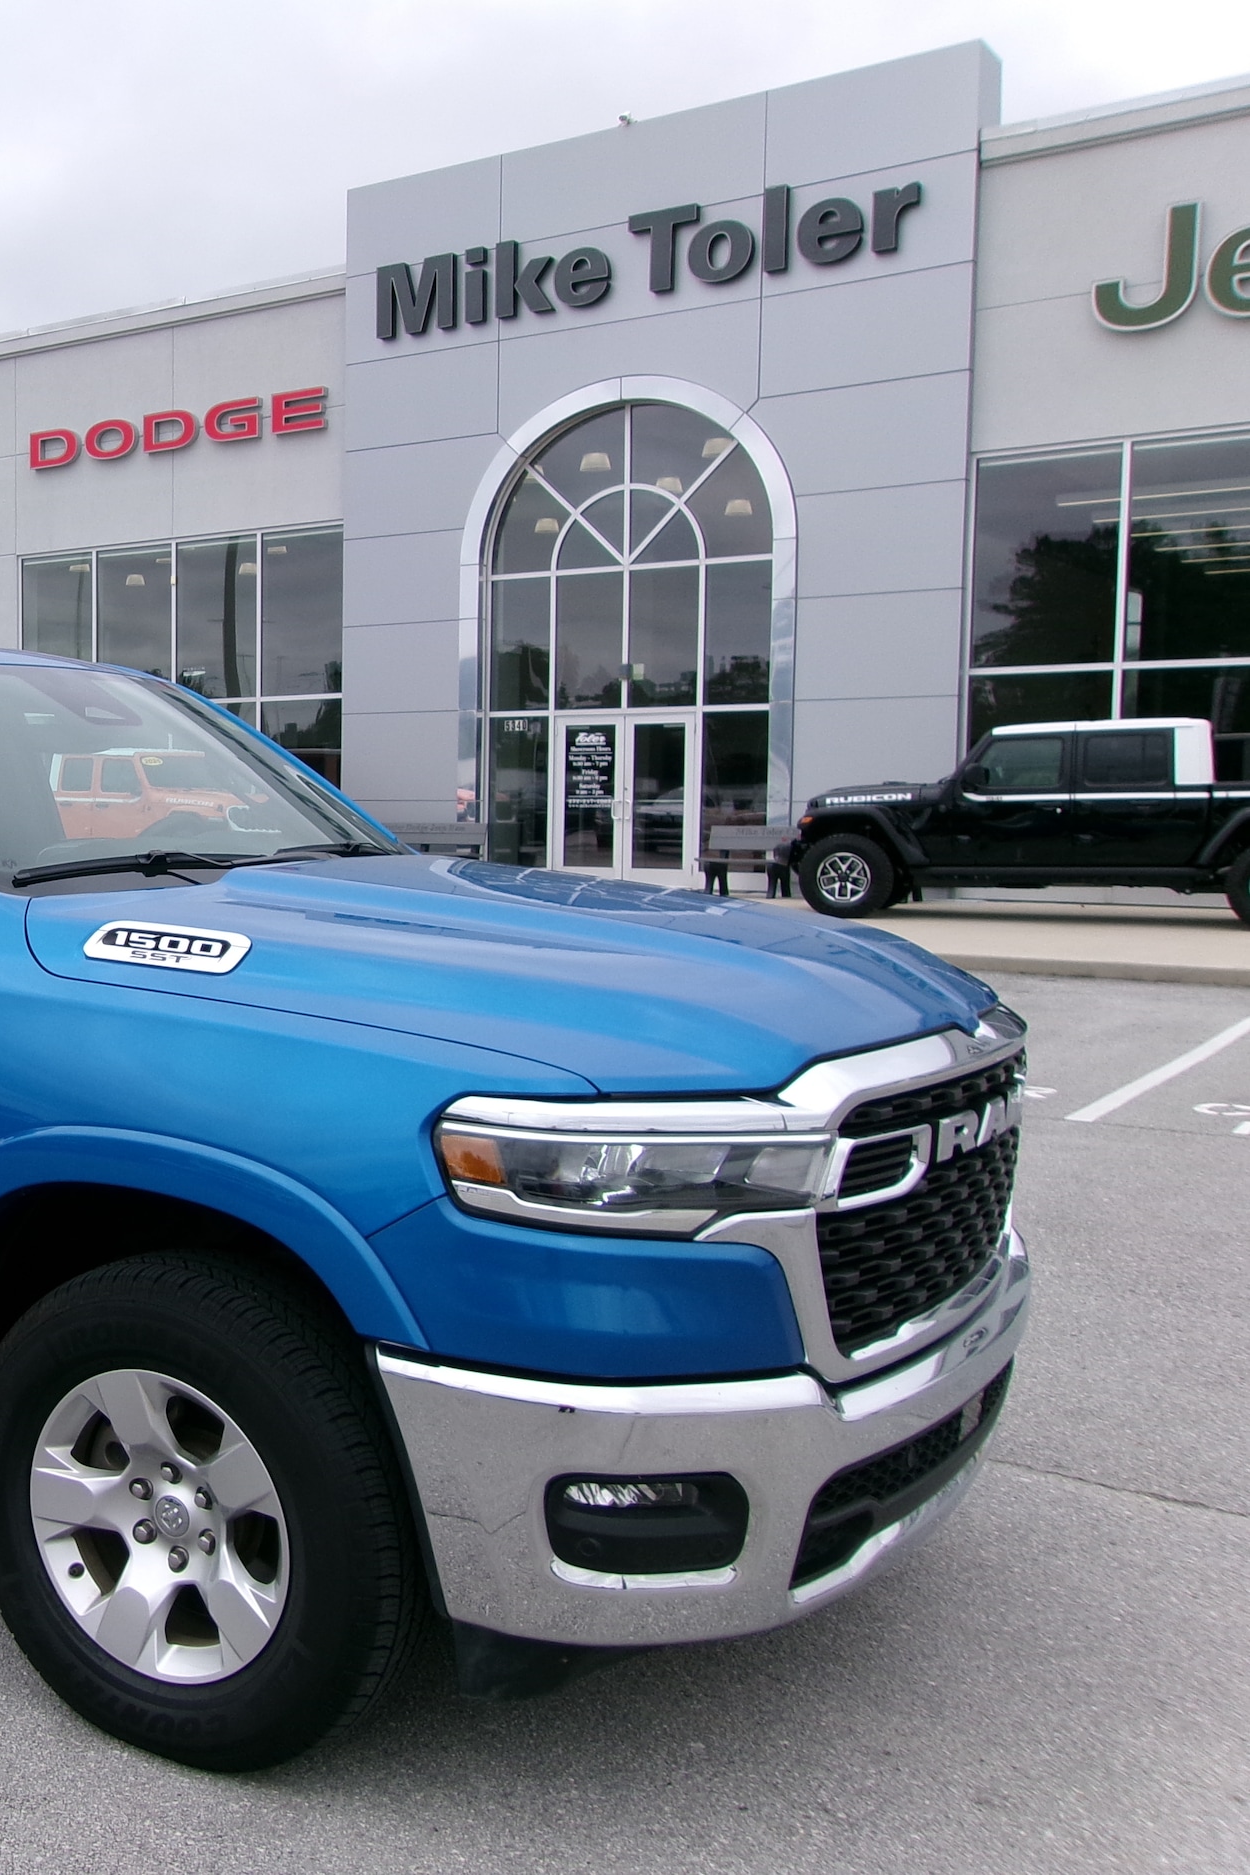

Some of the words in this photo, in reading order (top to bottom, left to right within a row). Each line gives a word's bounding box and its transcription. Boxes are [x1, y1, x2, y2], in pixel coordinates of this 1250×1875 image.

[375, 240, 612, 340] Mike
[628, 181, 922, 293] Toler
[29, 386, 329, 471] DODGE
[165, 797, 214, 807] RUBICON
[826, 793, 914, 805] RUBICON
[114, 930, 223, 958] 1500
[130, 950, 192, 963] SST
